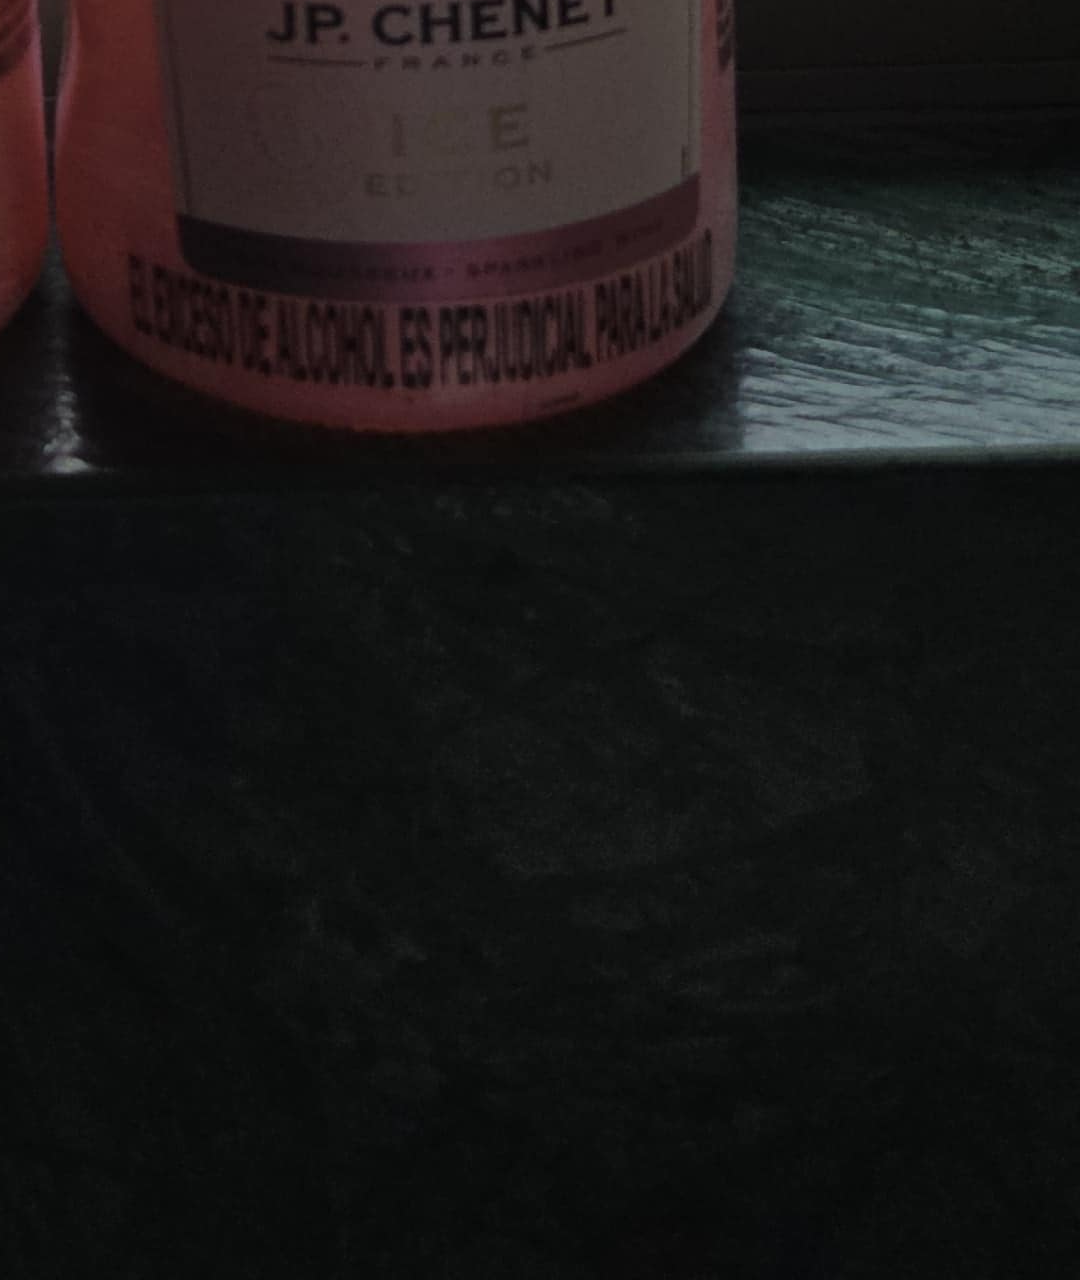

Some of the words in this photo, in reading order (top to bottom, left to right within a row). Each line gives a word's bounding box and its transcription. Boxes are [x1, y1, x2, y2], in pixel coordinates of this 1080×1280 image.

[265, 0, 350, 45] JP.
[372, 45, 543, 72] FRANCE
[390, 100, 529, 158] IE
[362, 157, 554, 199] EDON
[278, 299, 395, 388] ALCOHOL
[399, 306, 432, 389] ES
[438, 289, 594, 387] PERJUDICIAL
[595, 272, 647, 362] PARA
